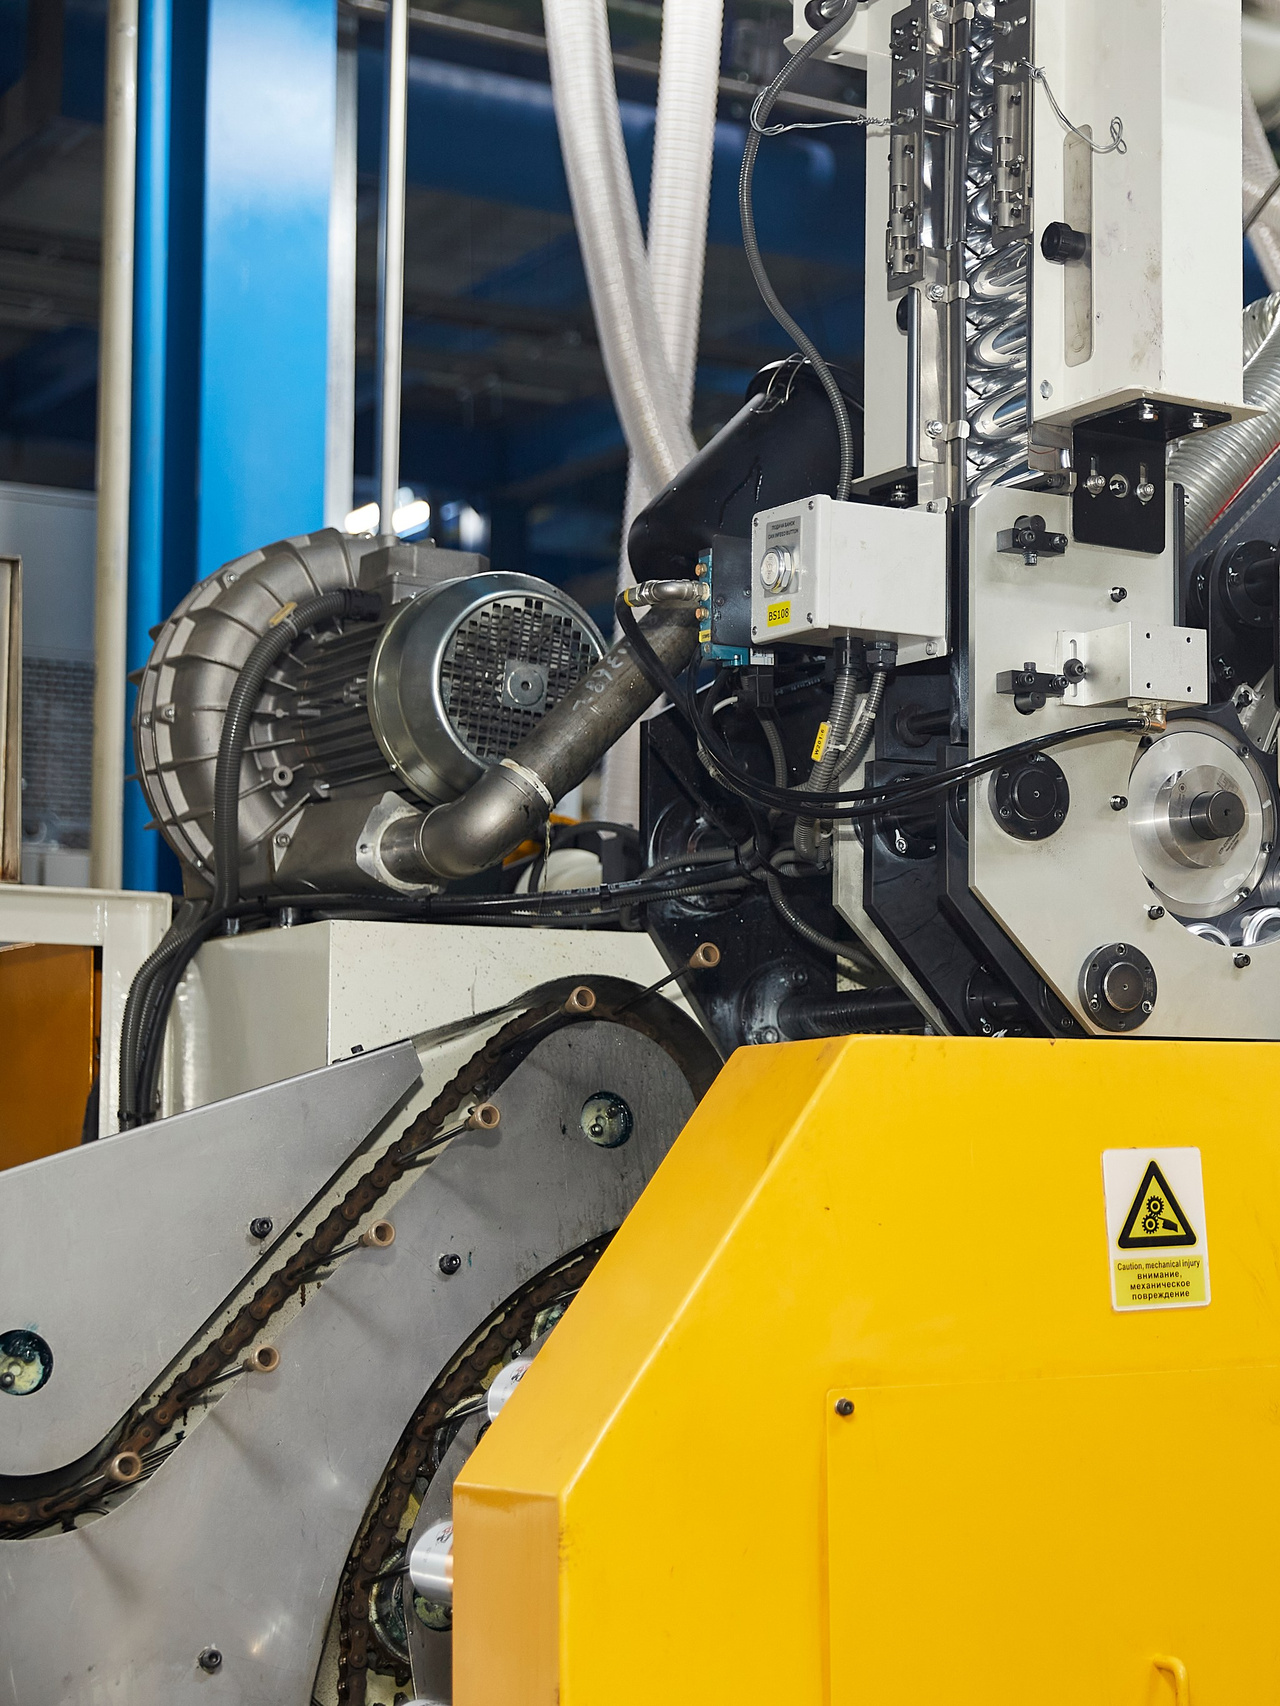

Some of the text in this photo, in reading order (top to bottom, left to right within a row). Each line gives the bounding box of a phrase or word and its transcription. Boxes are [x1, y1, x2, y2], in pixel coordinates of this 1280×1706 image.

[768, 607, 790, 622] BS108
[1117, 1259, 1201, 1271] Caution, mechanical injury
[1137, 1271, 1183, 1279] внимание,
[1130, 1280, 1191, 1290] механическое
[1132, 1290, 1190, 1301] повреждение
